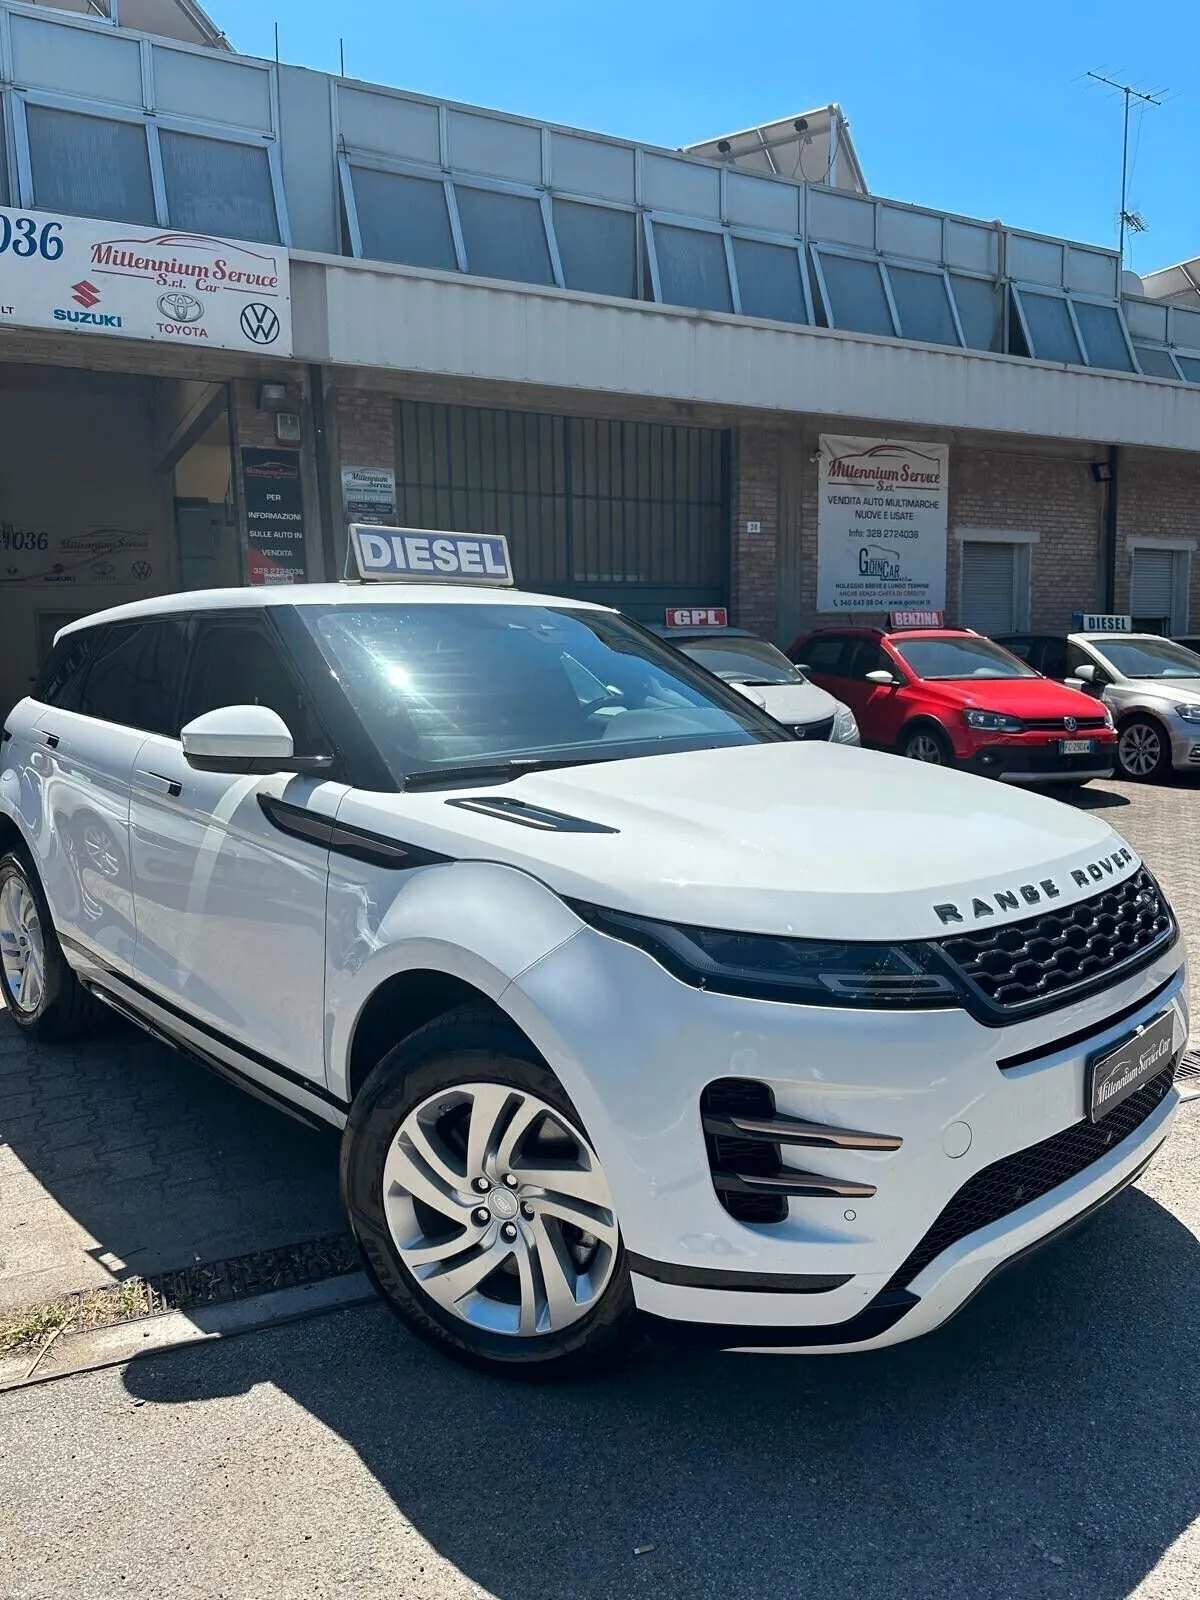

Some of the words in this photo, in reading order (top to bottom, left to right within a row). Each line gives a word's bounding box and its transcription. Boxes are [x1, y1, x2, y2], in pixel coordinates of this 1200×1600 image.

[91, 243, 209, 279] Millennium
[212, 259, 278, 288] Service
[156, 273, 186, 289] S.r.l.
[195, 277, 221, 293] Car
[53, 308, 122, 328] SUZUKI
[156, 322, 209, 338] TOYOTA
[828, 459, 899, 481] Millennium
[900, 463, 940, 484] Service
[369, 481, 392, 489] Service
[828, 496, 861, 506] VENDITA
[863, 497, 884, 507] AUTO
[885, 498, 940, 509] MULTIMARCHE
[248, 511, 301, 520] INFORMAZIONI
[855, 510, 882, 520] NUOVE
[884, 511, 888, 519] E
[890, 511, 914, 521] USATE
[249, 530, 272, 538] SULLE
[273, 531, 293, 539] AUTO
[294, 531, 303, 539] IN
[849, 528, 864, 538] Info:
[866, 529, 882, 538] 328
[883, 529, 919, 539] 2724036
[262, 549, 293, 557] VENDITA
[359, 533, 507, 574] DIESEL
[674, 610, 719, 625] GPL
[895, 612, 939, 626] BENZINA
[1088, 616, 1127, 630] DIESEL
[933, 879, 1060, 925] RANGE
[1071, 847, 1133, 888] ROVER
[1096, 1067, 1138, 1106] Millennium
